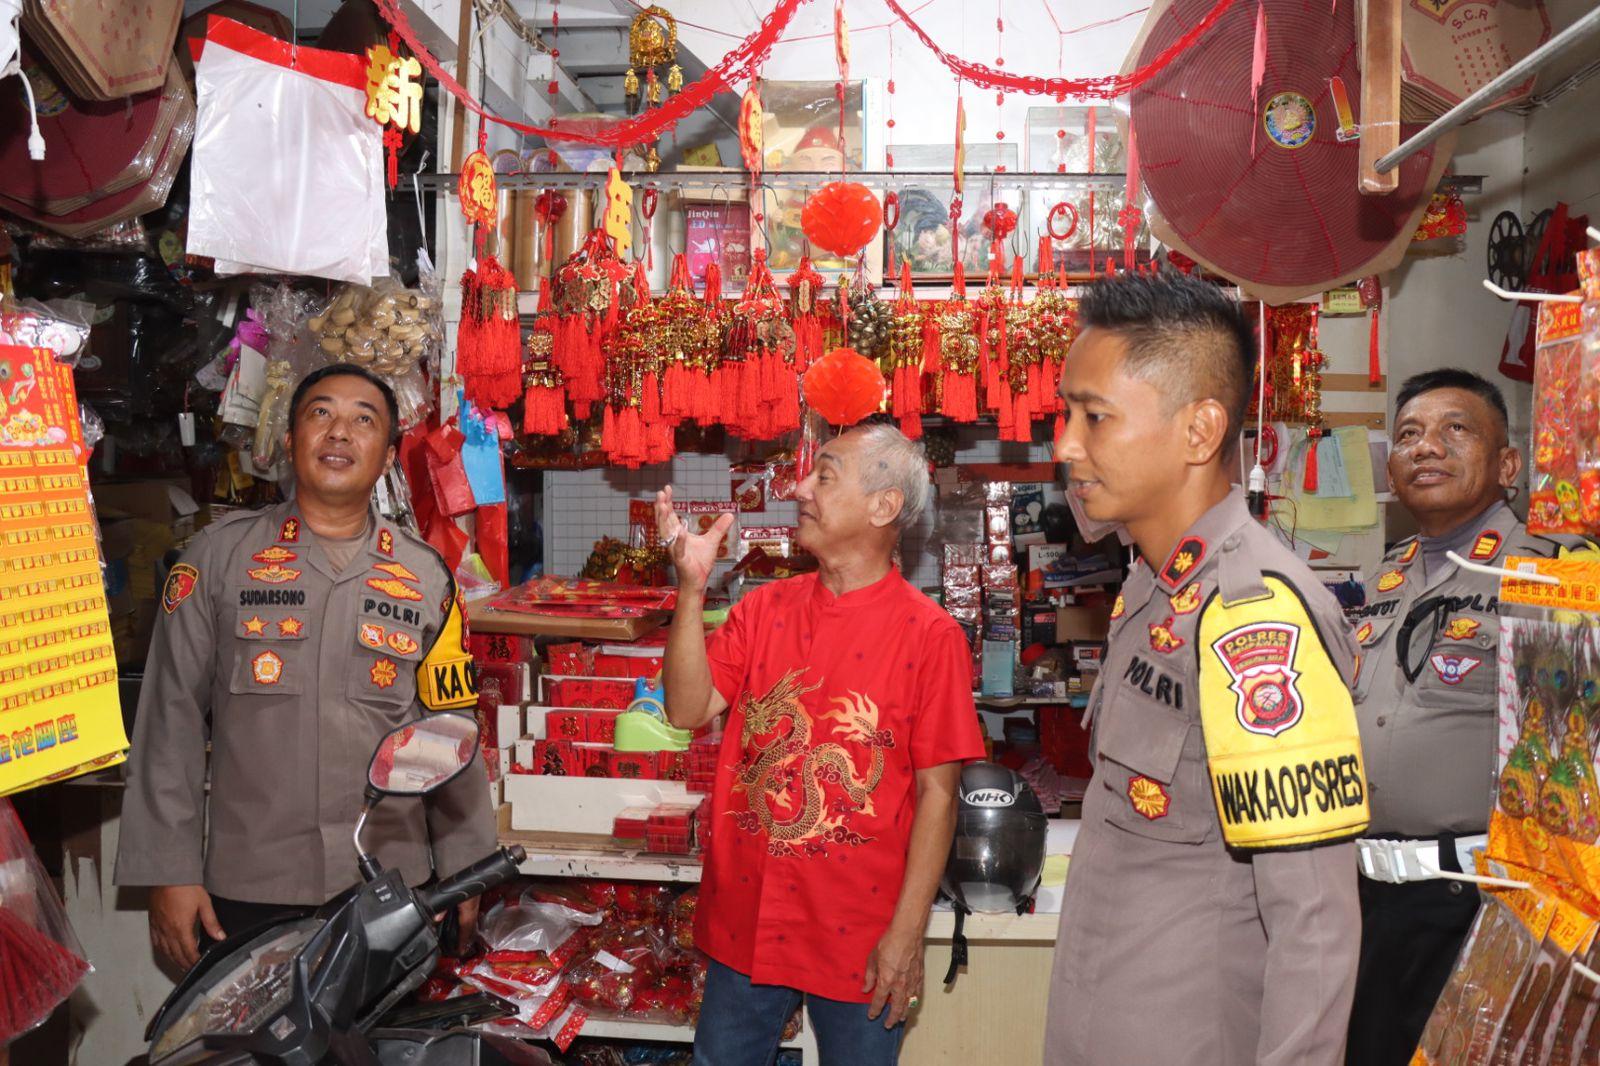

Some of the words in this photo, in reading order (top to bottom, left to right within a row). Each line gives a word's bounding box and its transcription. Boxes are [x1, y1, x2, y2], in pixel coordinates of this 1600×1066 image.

[239, 589, 306, 606] SUDARSONO
[1448, 593, 1503, 615] POLR
[363, 598, 421, 626] POLRI
[1224, 630, 1288, 655] POLRES
[1123, 656, 1183, 711] POLRI
[971, 792, 1009, 803] NHK
[1216, 753, 1364, 826] WAKAOPSRES
